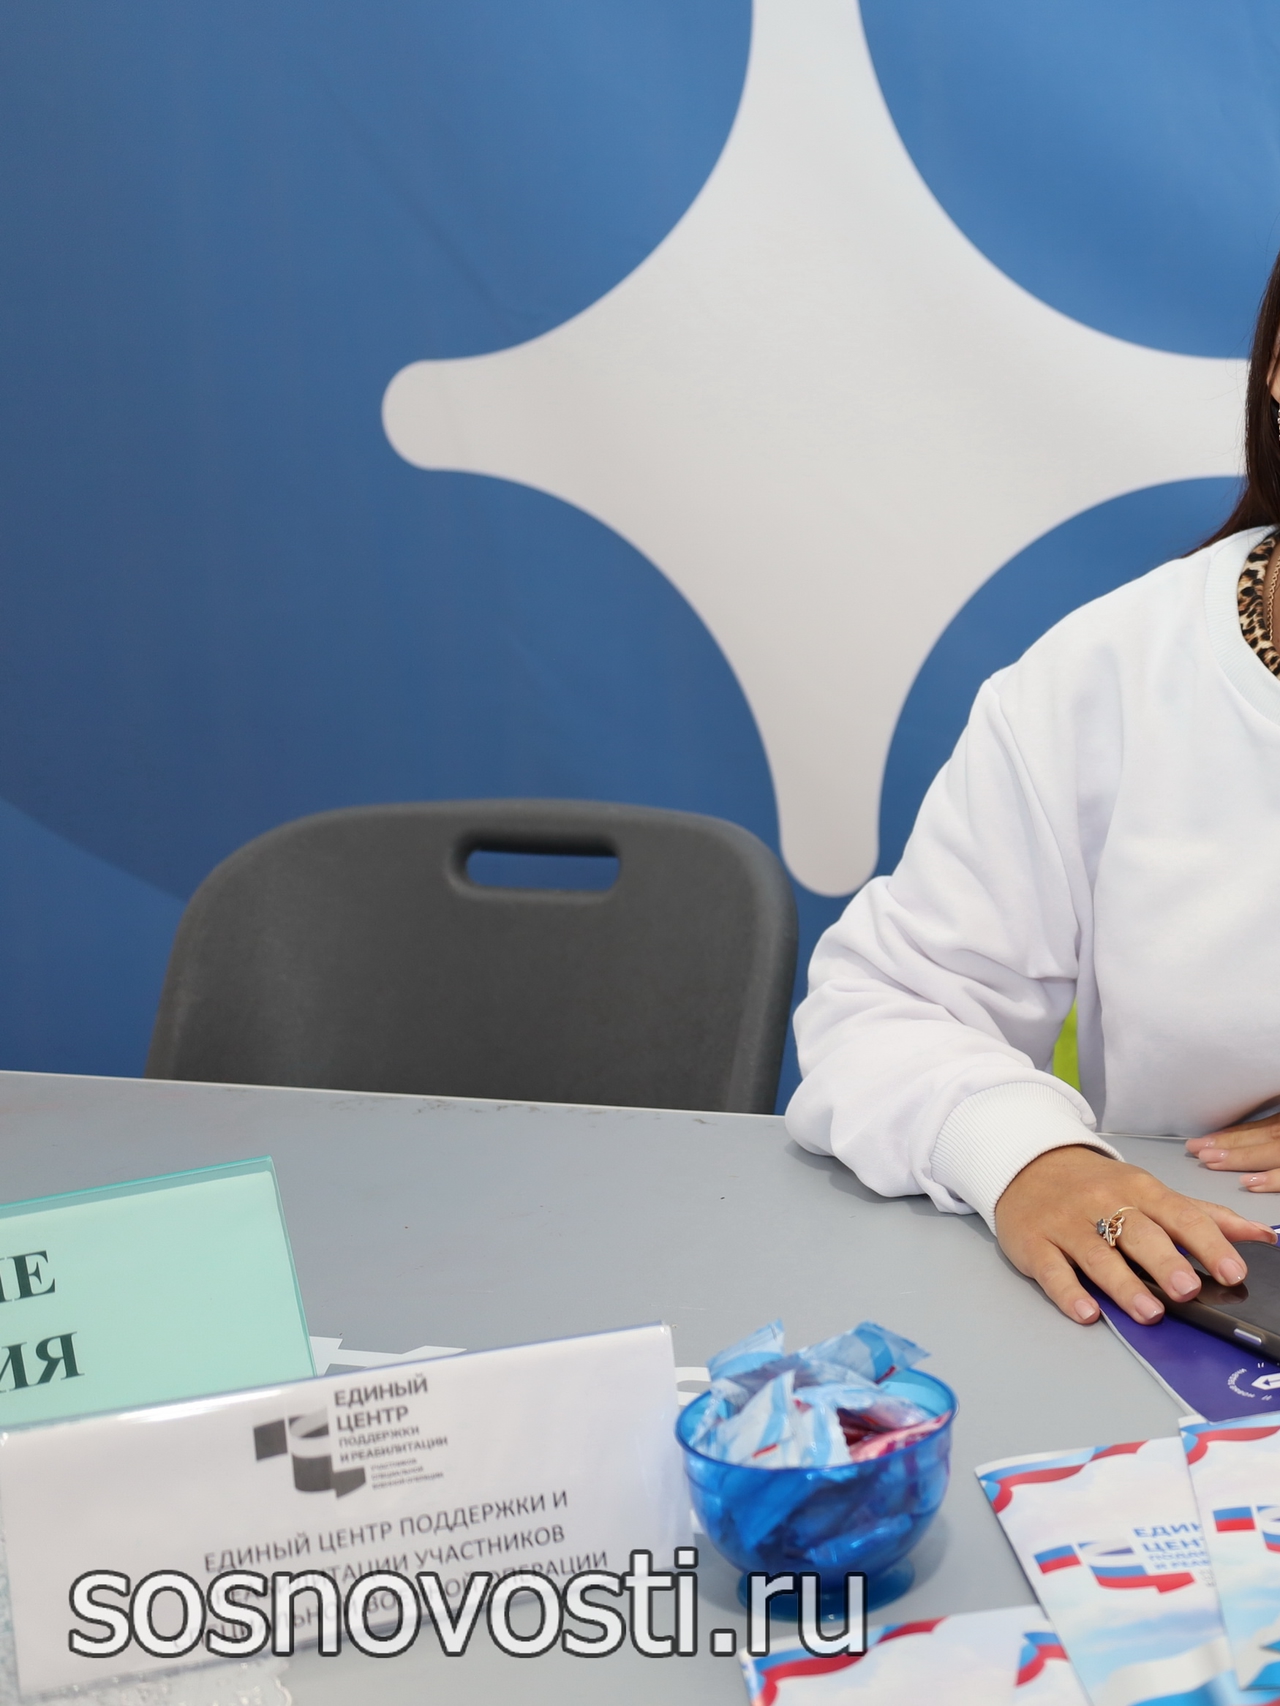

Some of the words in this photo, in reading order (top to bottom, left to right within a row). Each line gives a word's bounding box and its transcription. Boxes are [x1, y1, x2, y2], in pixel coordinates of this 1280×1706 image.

[0, 1250, 56, 1303] Е
[334, 1372, 429, 1407] ЕДИНЫЙ
[336, 1405, 409, 1432] ЦЕНТР
[339, 1426, 420, 1448] ПОДДЕРЖКИ
[351, 1436, 448, 1462] РЕАБИЛИТАЦИИ
[204, 1531, 311, 1573] ЕДИНЫЙ
[318, 1521, 393, 1553] ЦЕНТР
[400, 1494, 546, 1537] ПОДДЕРЖКИ
[552, 1490, 568, 1510] И
[414, 1524, 565, 1569] УЧАСТНИКОВ
